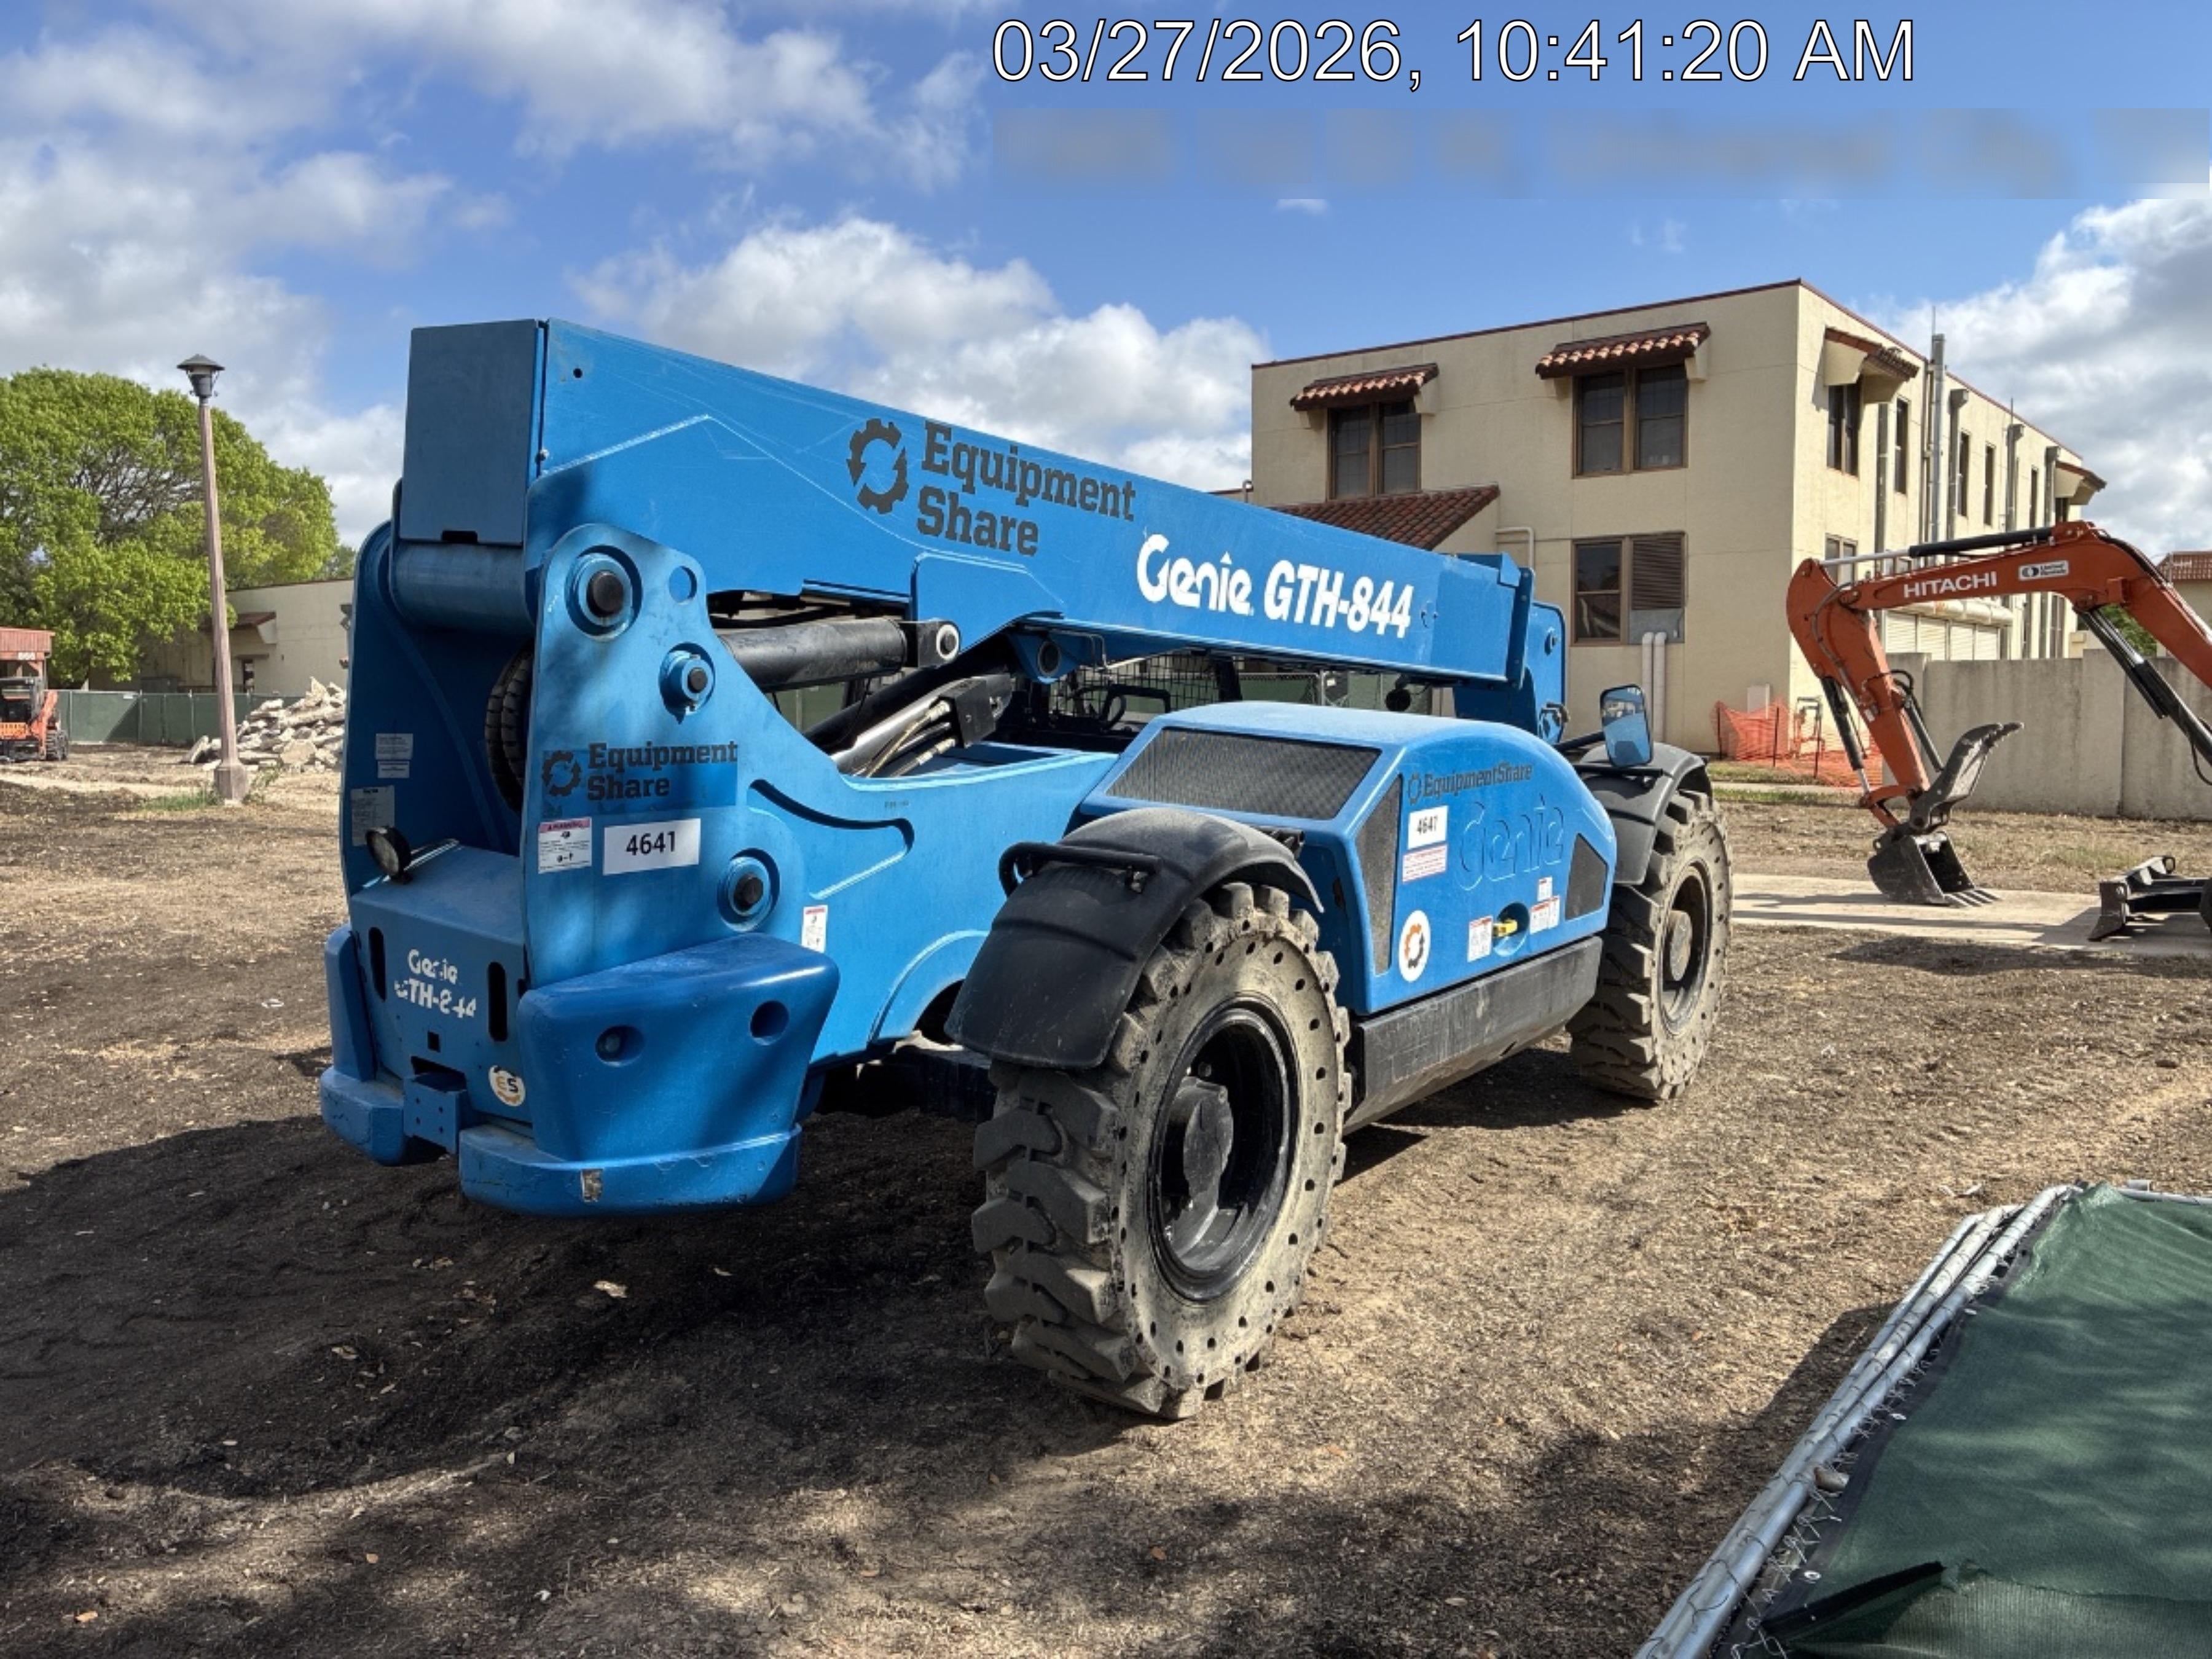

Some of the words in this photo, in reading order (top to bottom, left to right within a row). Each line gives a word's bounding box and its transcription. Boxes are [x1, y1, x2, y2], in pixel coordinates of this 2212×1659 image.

[921, 420, 1136, 522] Equipment
[917, 484, 1038, 557] Share
[1136, 533, 1252, 616] Genie
[1263, 559, 1414, 639] GTH-844
[1904, 570, 1998, 598] HITACHI
[588, 740, 739, 773] Equipment
[587, 775, 670, 801] Share
[1424, 761, 1532, 798] EquipmentShare
[626, 831, 676, 856] 4641
[1459, 792, 1566, 892] Genie
[496, 1075, 519, 1094] ES
